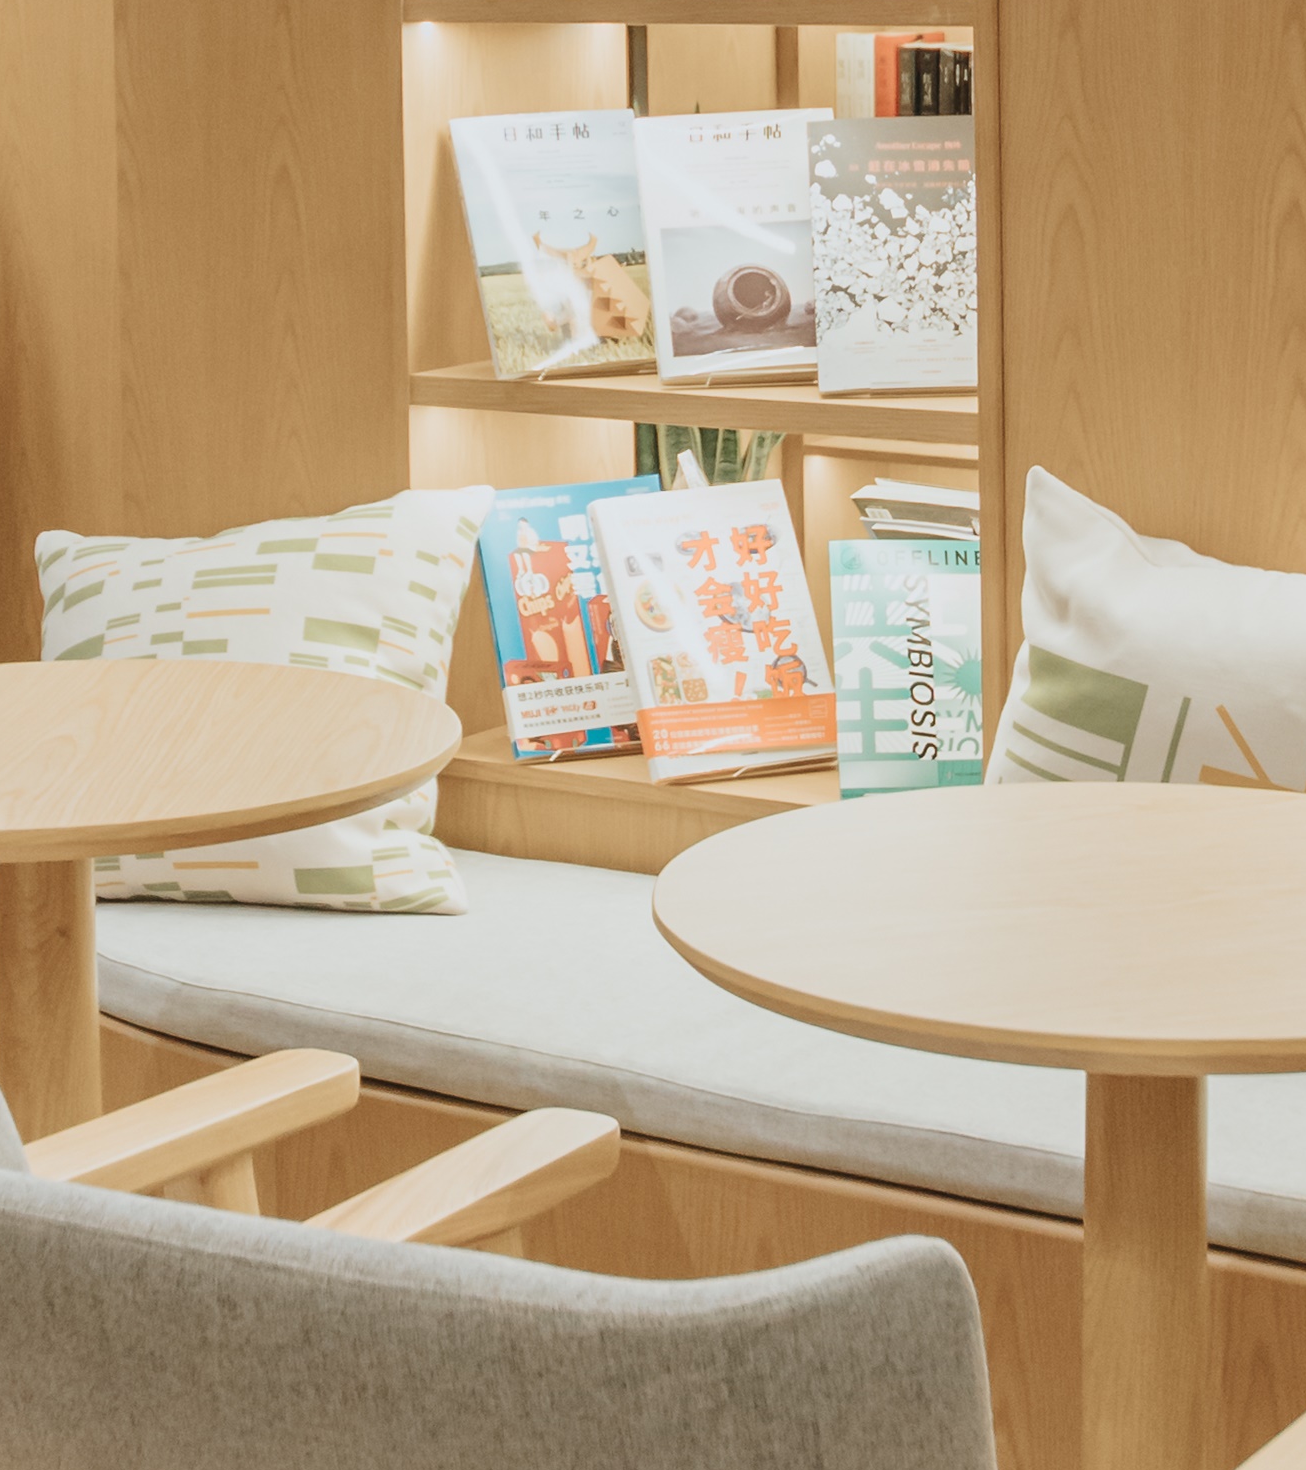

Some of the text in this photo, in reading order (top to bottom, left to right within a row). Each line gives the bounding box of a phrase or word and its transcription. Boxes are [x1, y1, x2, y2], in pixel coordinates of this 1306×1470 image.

[729, 523, 805, 698] 好好吃饭
[876, 549, 982, 567] OFFLINE
[902, 573, 940, 763] SYMBIOSIS
